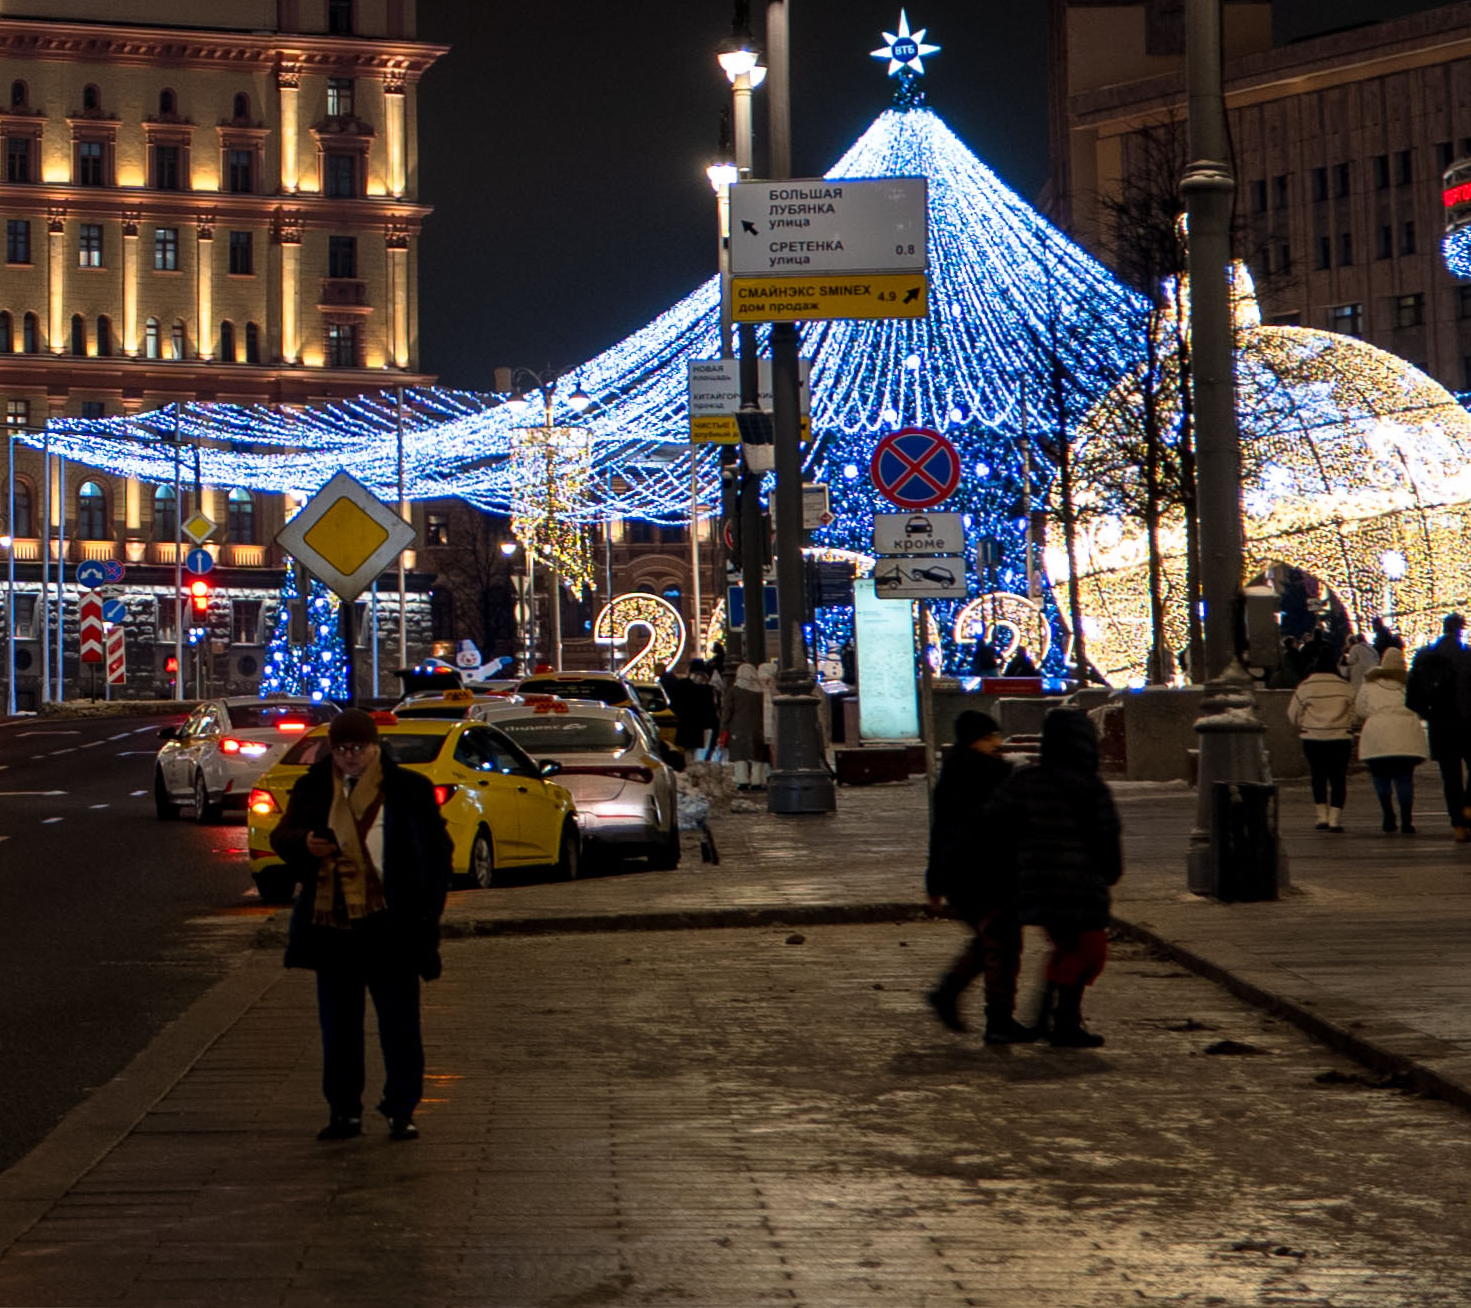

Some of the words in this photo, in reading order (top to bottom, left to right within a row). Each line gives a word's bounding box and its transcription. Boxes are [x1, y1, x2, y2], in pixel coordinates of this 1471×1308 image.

[895, 45, 915, 55] ВТБ
[769, 188, 843, 201] БОЛЬШАЯ
[769, 203, 836, 216] ЛУБЯНКА
[769, 218, 810, 230] улица
[769, 241, 844, 252] СРЕТЕНКА
[895, 245, 915, 255] 0.8
[769, 255, 810, 267] улица
[738, 285, 816, 298] СМАЙНЭКС
[819, 285, 871, 296] SMINEX
[877, 292, 897, 302] 4.9
[738, 303, 765, 314] дом
[769, 302, 820, 314] продаж
[692, 365, 724, 373] НОВАЯ
[893, 537, 945, 552] кроме
